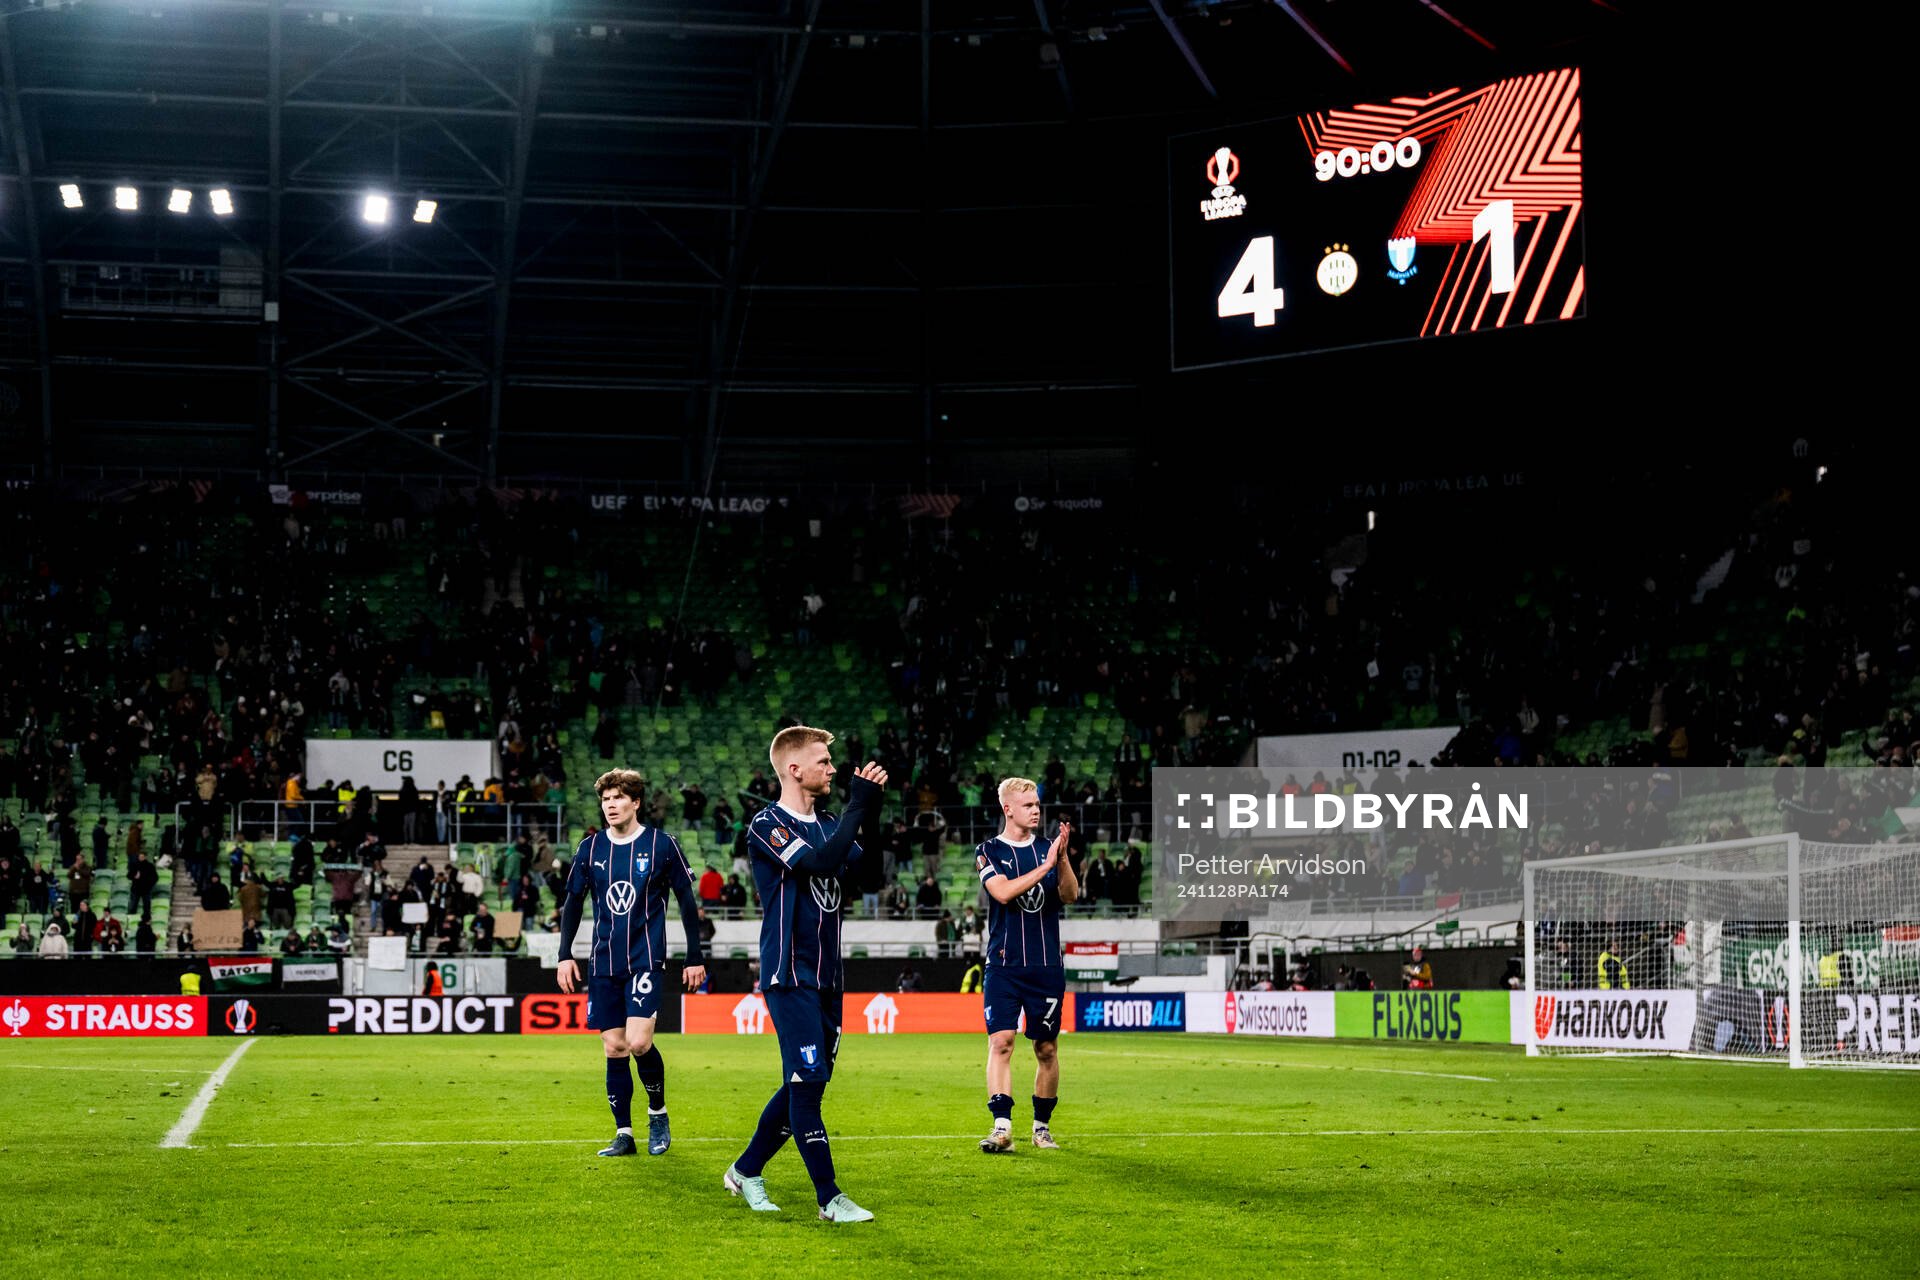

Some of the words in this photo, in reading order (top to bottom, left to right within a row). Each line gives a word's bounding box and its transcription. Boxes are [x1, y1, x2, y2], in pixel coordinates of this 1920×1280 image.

[1315, 137, 1421, 182] 90:00
[1472, 200, 1515, 294] 1
[1218, 236, 1284, 327] 4
[383, 750, 413, 772] C6
[632, 972, 653, 994] 16
[45, 1003, 194, 1031] STRAUSS
[328, 998, 514, 1033] PREDICT
[530, 1000, 586, 1029] SI
[1044, 998, 1058, 1020] 7
[1084, 1000, 1182, 1027] #FOOTBALL
[1238, 996, 1308, 1035] Swissquote
